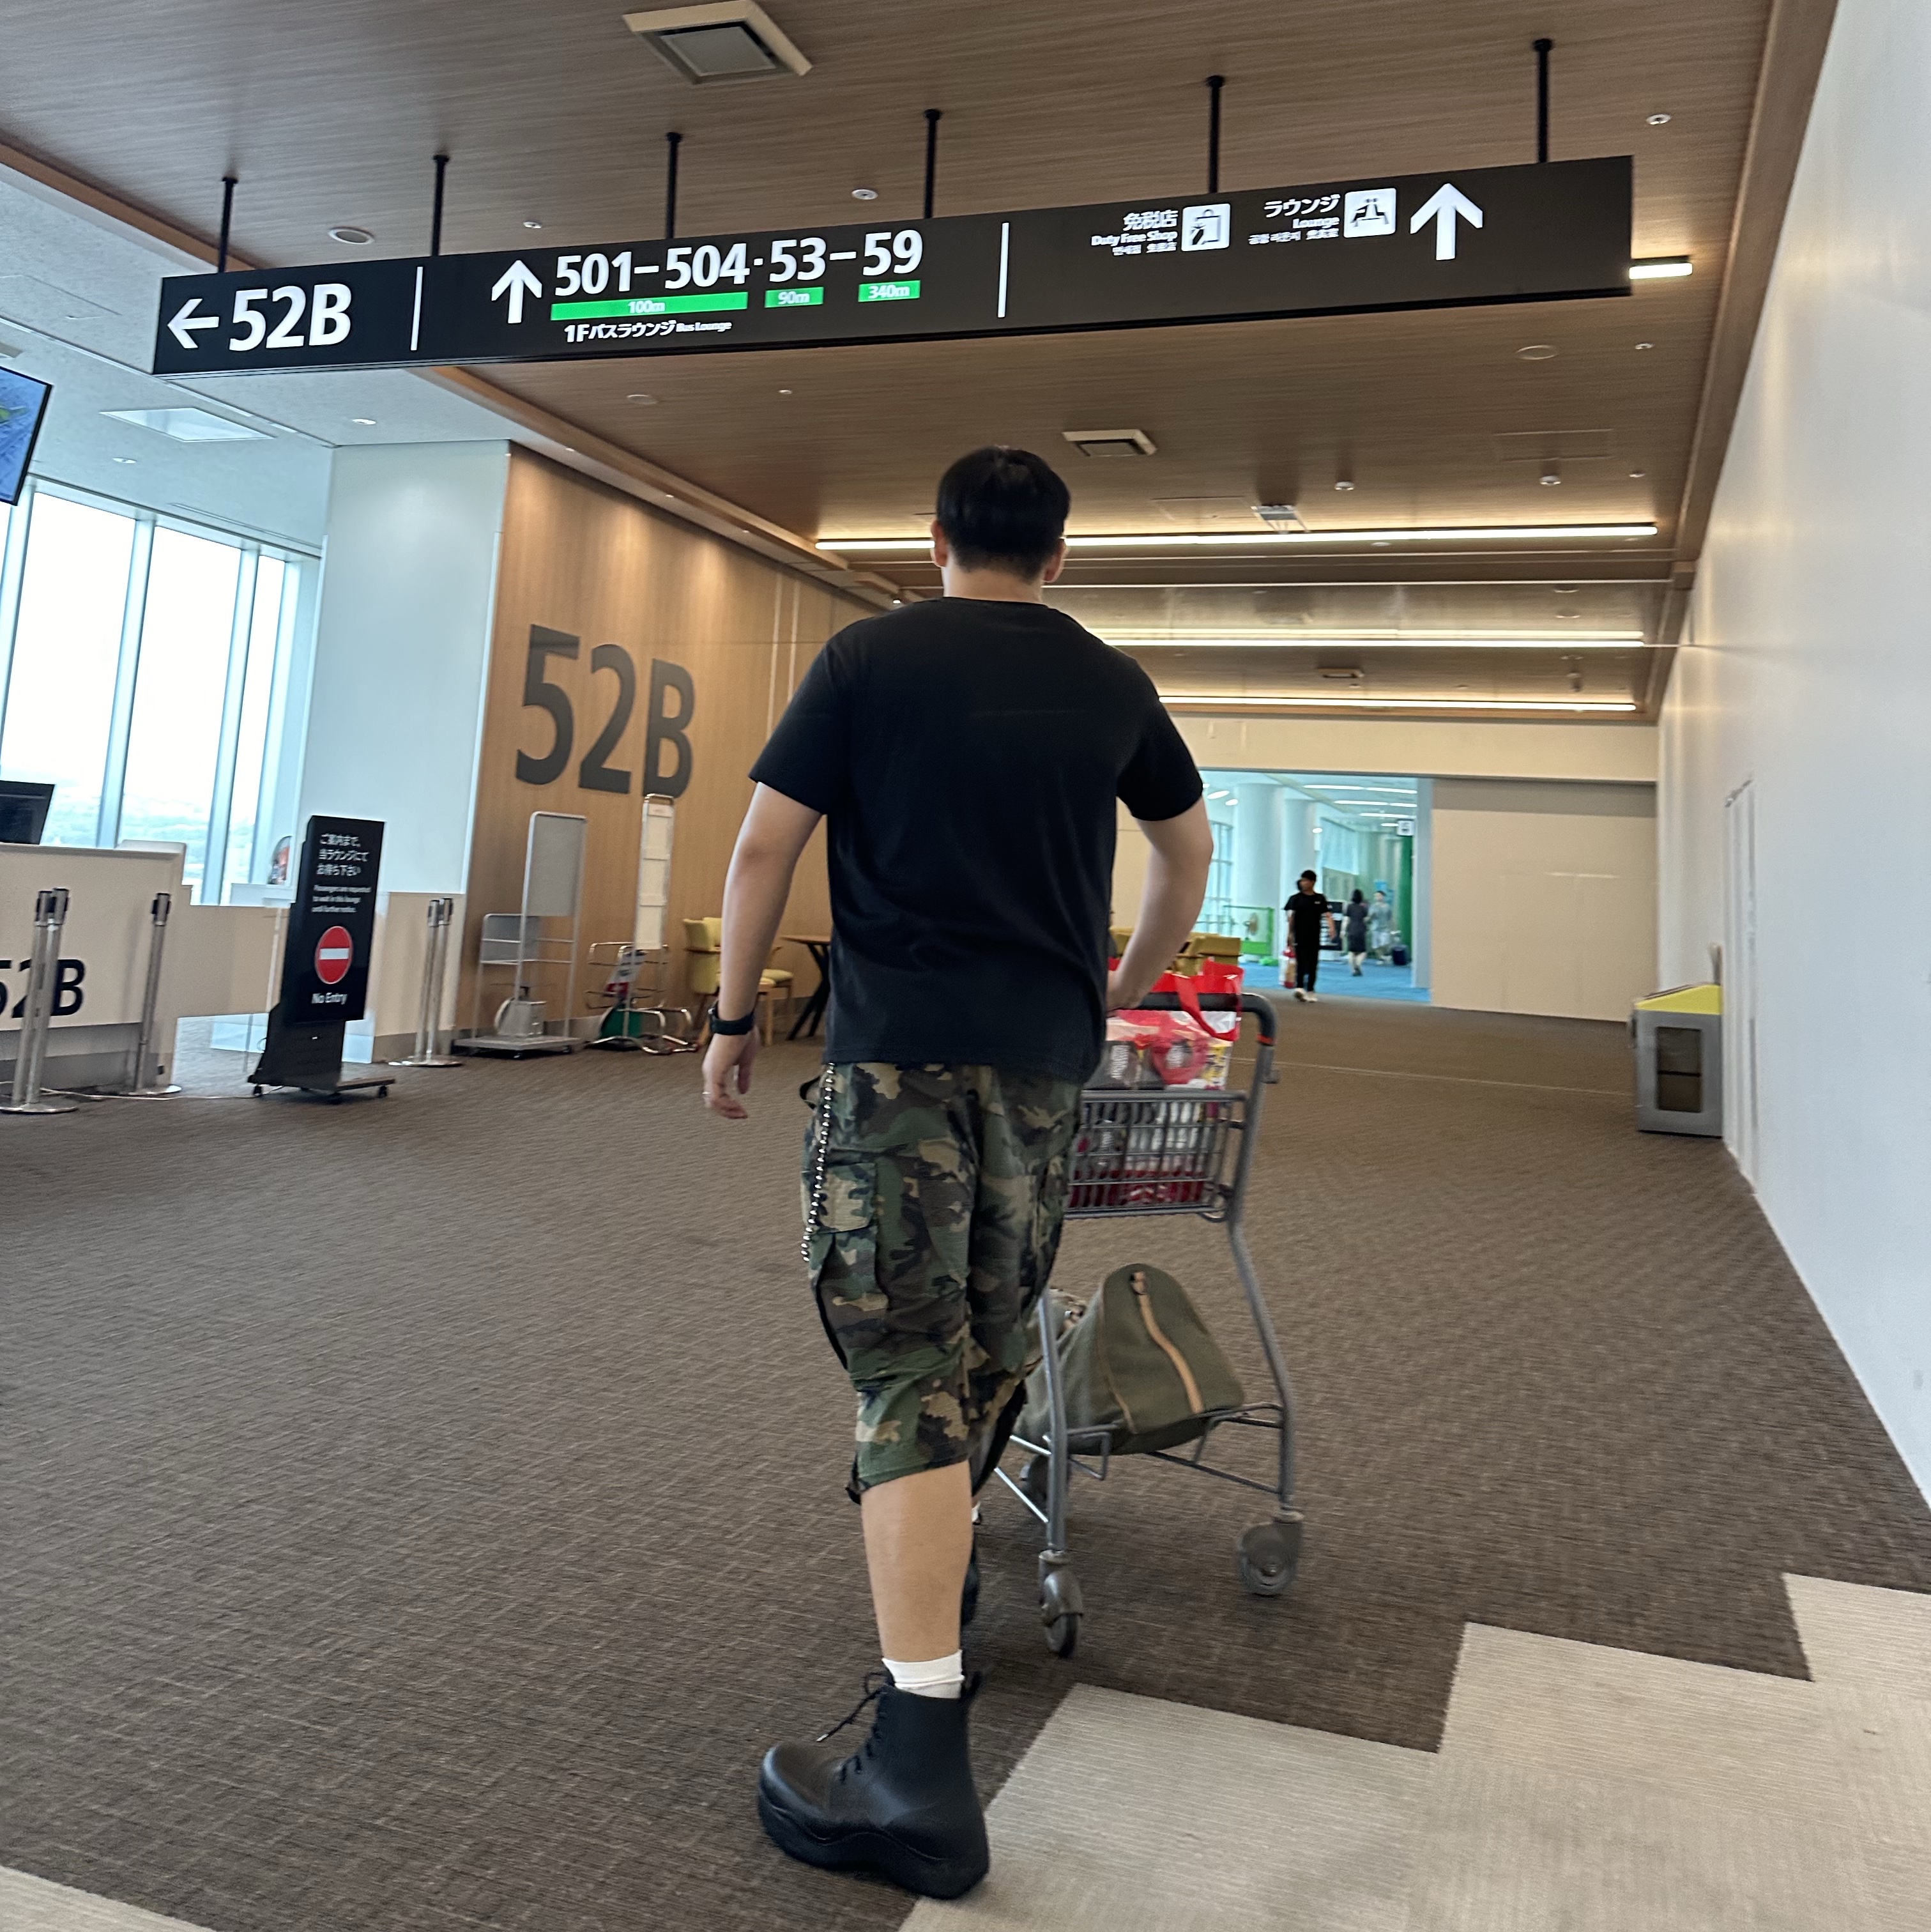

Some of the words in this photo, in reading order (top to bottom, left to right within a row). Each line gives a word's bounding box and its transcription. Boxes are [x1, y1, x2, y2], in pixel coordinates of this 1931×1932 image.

[1263, 194, 1341, 218] ラウンジ
[1122, 209, 1179, 231] 免税店
[1292, 217, 1340, 229] Lounge
[1090, 234, 1121, 247] Duty
[1120, 233, 1147, 243] Free
[1147, 230, 1178, 242] Shop
[777, 289, 810, 305] 90m
[867, 282, 910, 300] 340m
[627, 300, 666, 314] 100m
[229, 283, 352, 351] 52B
[515, 624, 696, 800] 52B
[311, 993, 324, 1004] No
